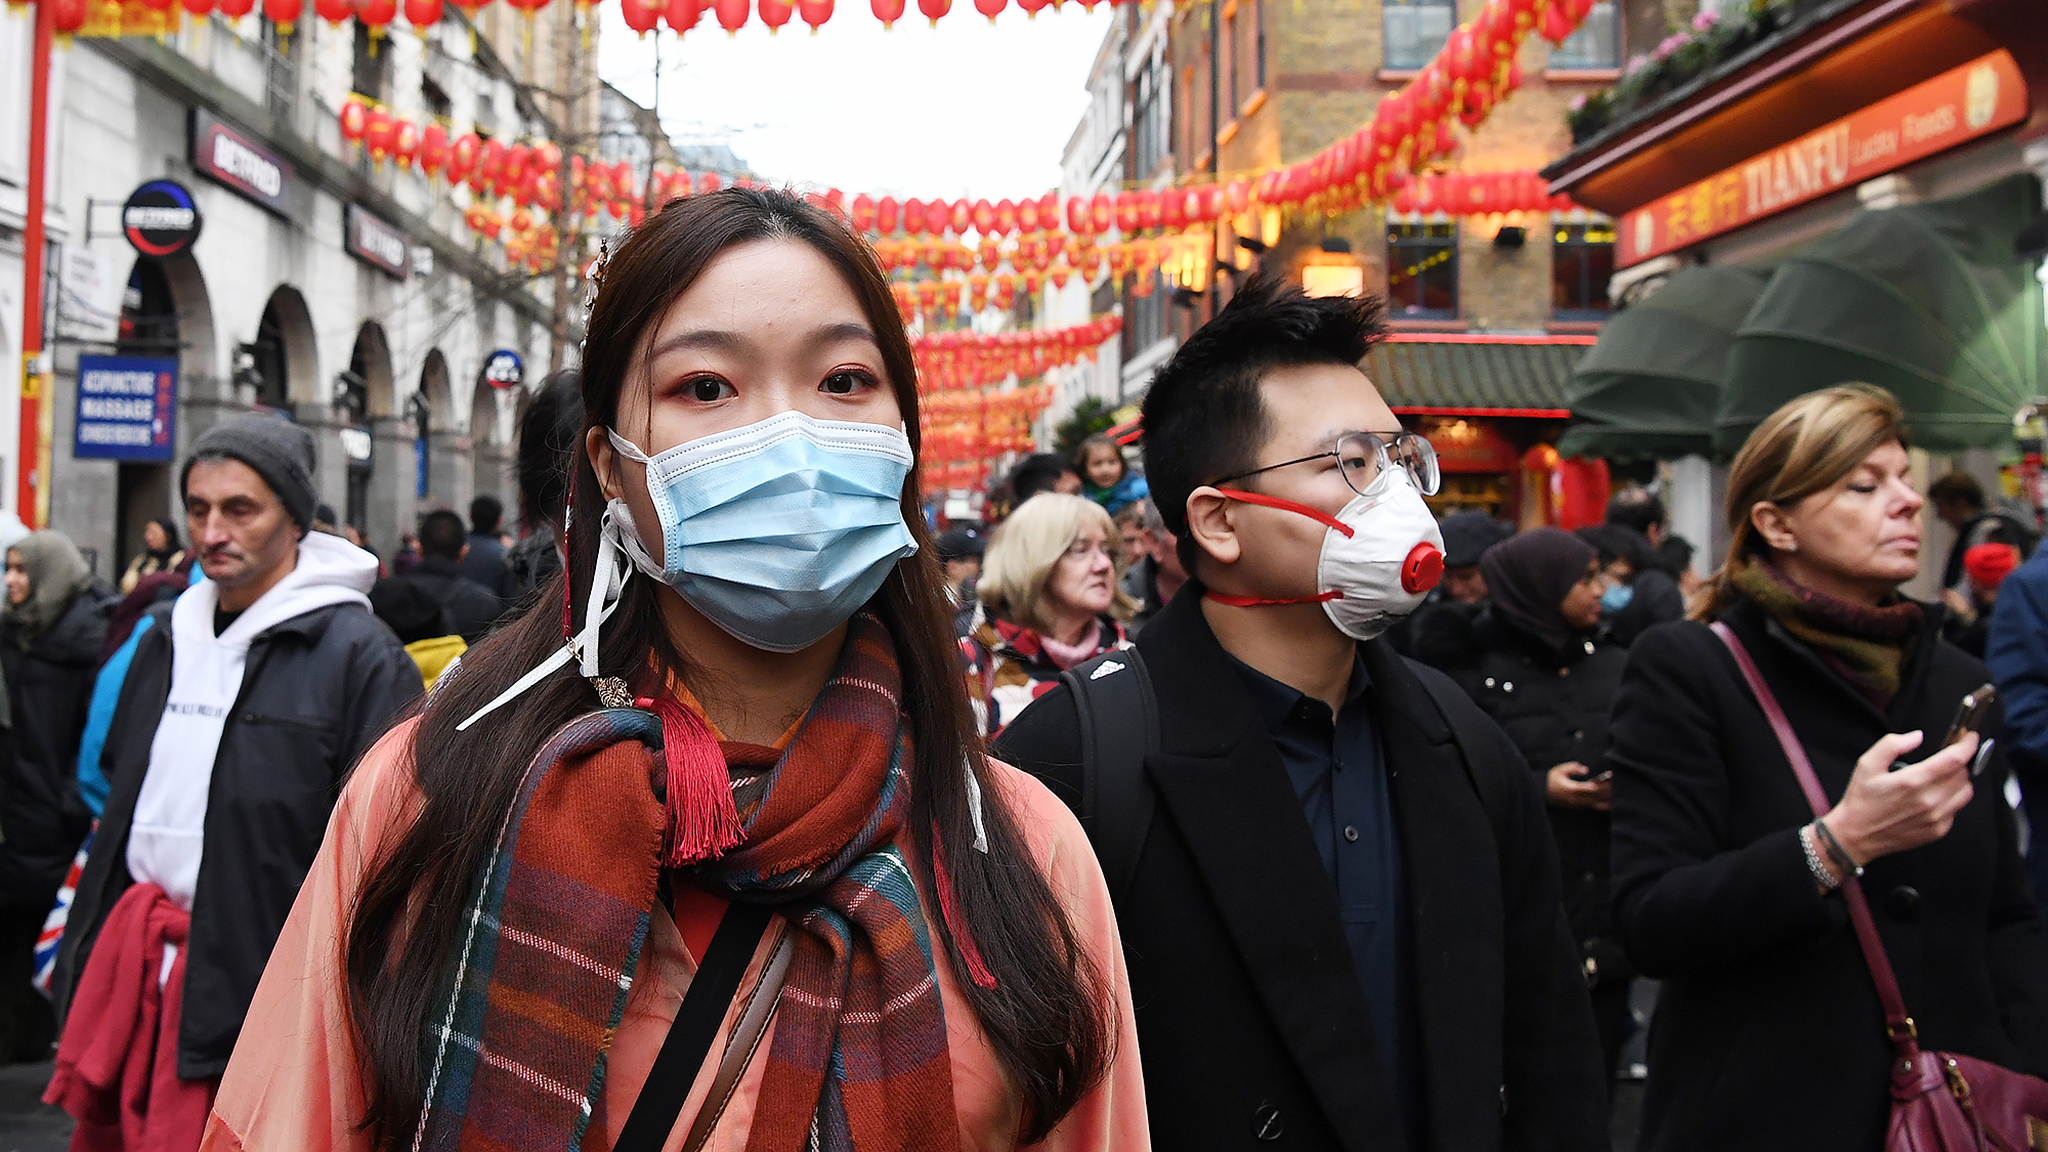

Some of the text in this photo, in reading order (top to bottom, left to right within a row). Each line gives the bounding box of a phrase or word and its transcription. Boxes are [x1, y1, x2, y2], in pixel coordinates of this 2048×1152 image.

[1743, 122, 1850, 217] TIANFU
[1901, 104, 1957, 142] Foods
[81, 397, 154, 422] MASSAGE
